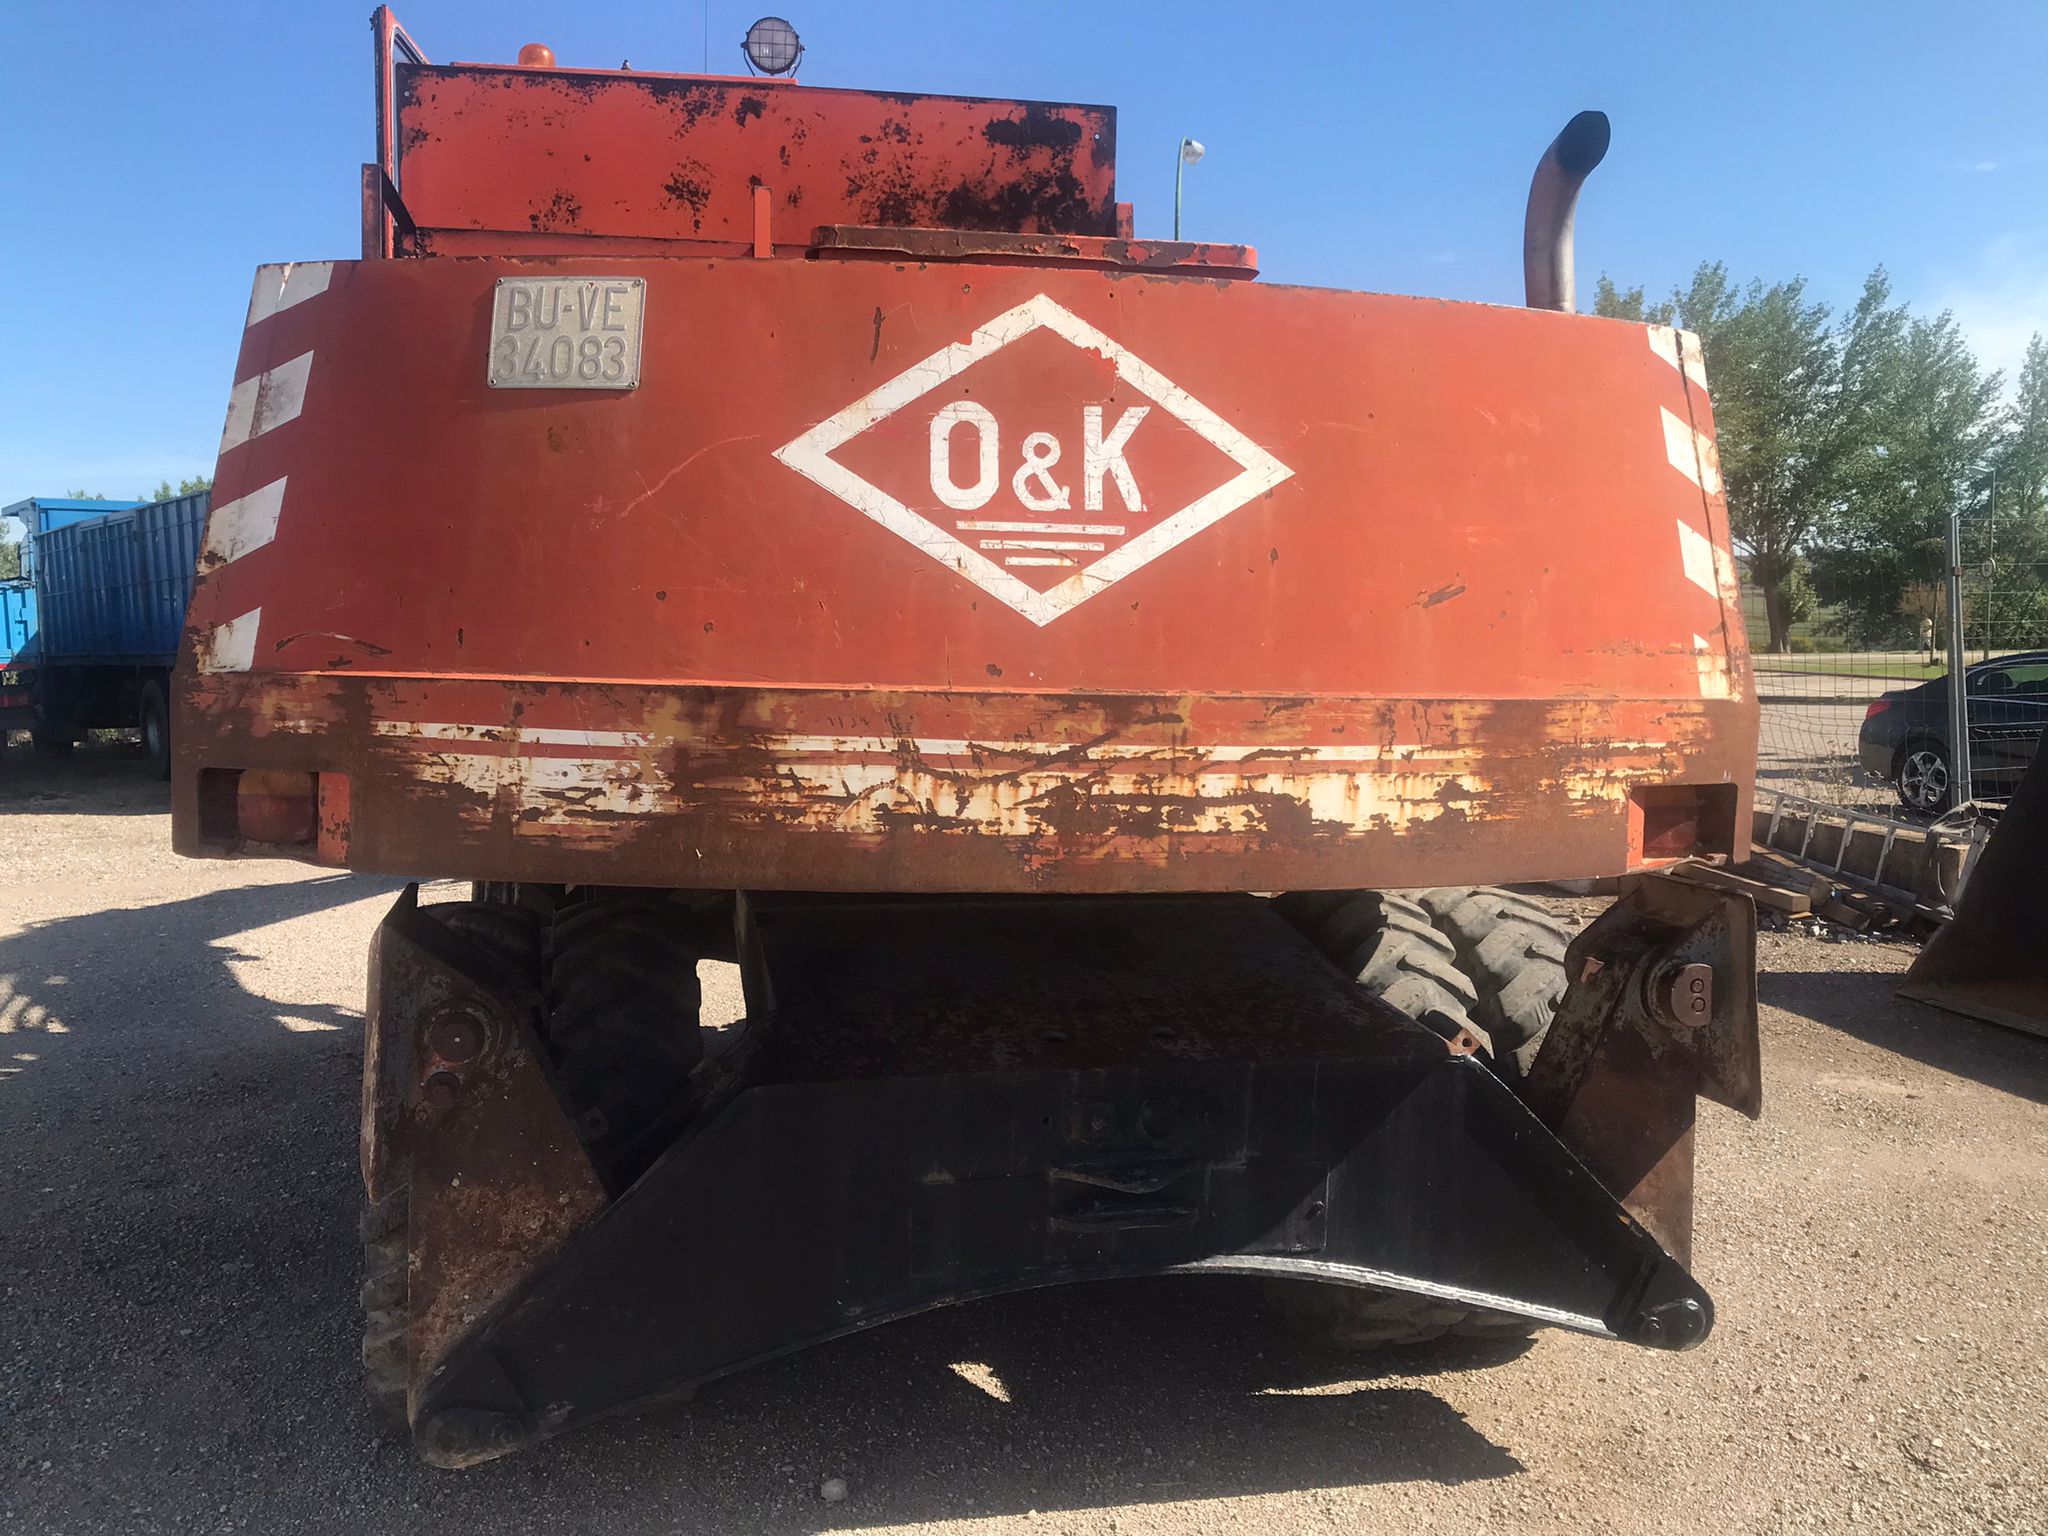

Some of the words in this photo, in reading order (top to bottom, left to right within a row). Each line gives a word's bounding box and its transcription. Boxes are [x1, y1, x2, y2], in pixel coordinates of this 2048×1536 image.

[507, 286, 628, 331] BU-VE
[496, 335, 626, 380] 34083
[929, 400, 1150, 512] O&K
